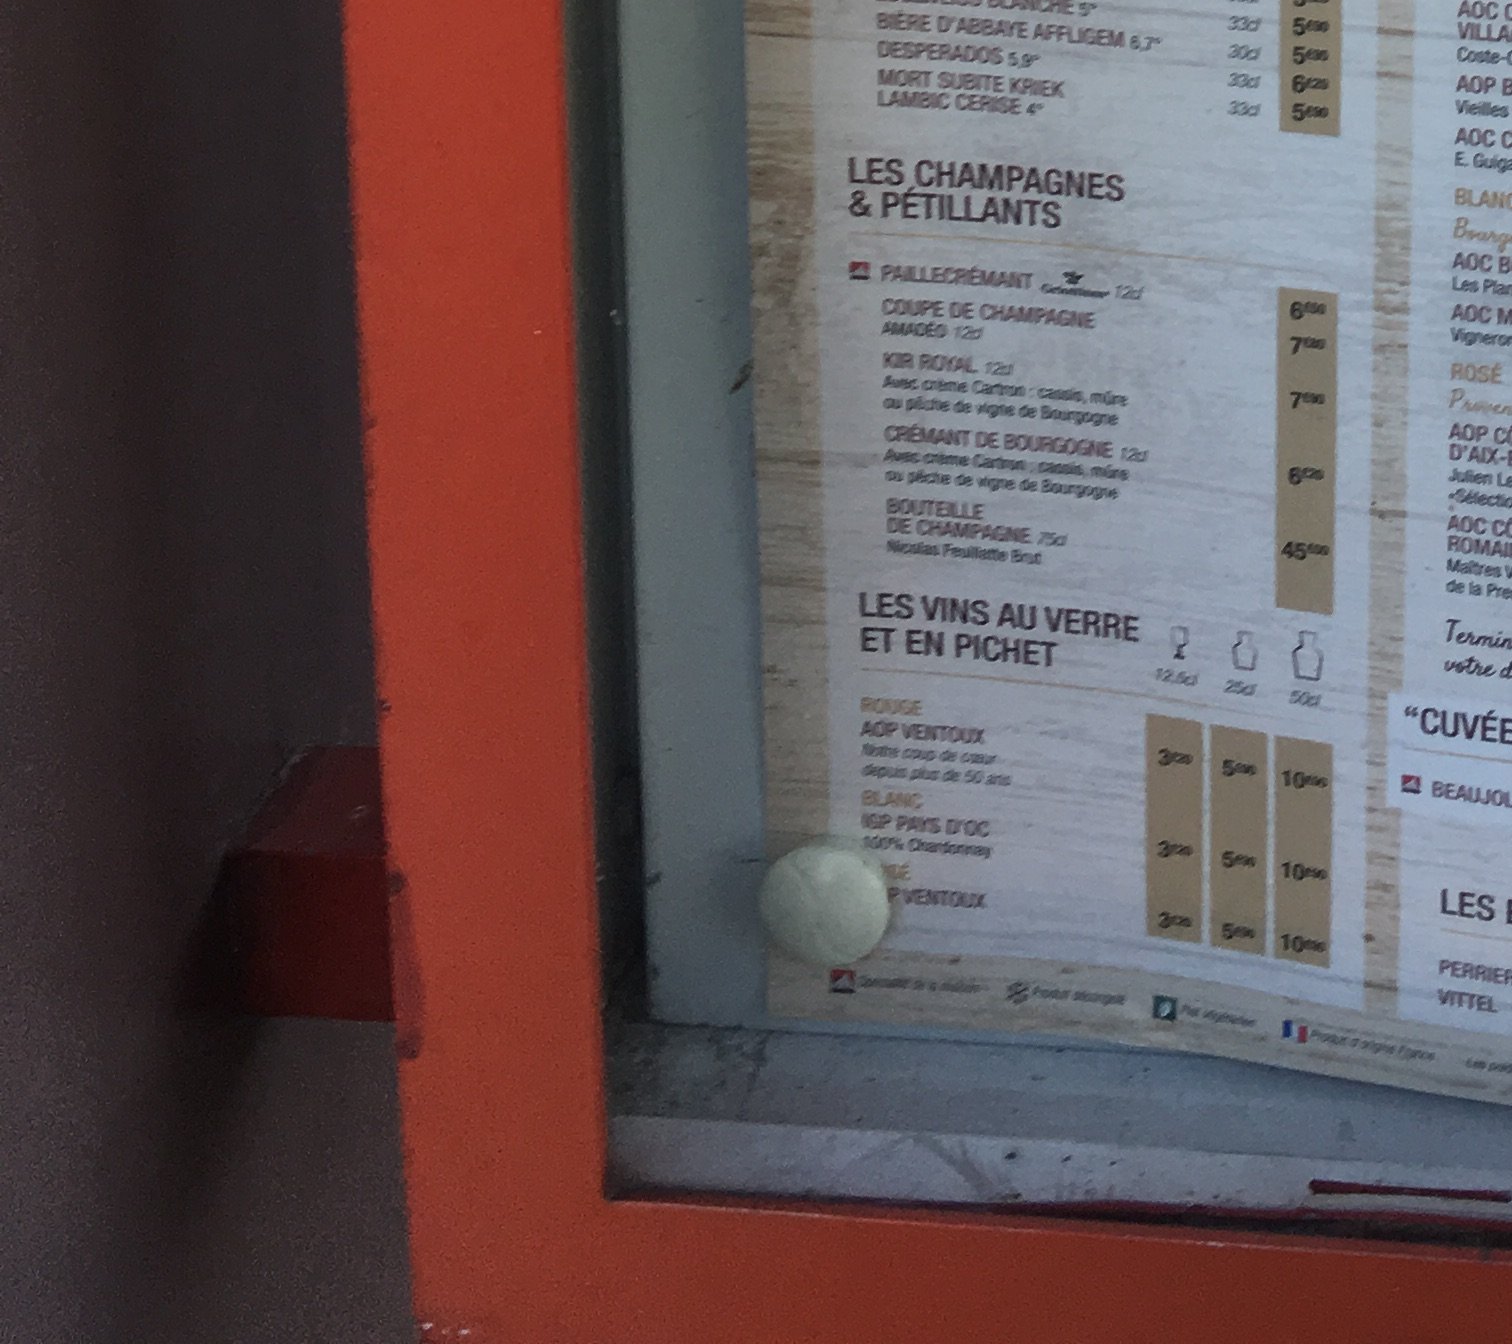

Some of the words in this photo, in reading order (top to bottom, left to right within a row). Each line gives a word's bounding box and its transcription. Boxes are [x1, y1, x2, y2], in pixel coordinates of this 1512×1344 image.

[849, 157, 904, 187] LES
[915, 160, 1125, 201] CHAMPAGNES
[850, 191, 870, 218] &
[881, 186, 1061, 229] PÉTILLANTS
[858, 592, 914, 620] LES
[921, 596, 990, 626] VINS
[997, 603, 1038, 630] AU
[1046, 607, 1139, 643] VERRE
[861, 627, 897, 653] ET
[906, 631, 944, 657] EN
[955, 634, 1059, 668] PICHET
[1440, 889, 1496, 921] LES
